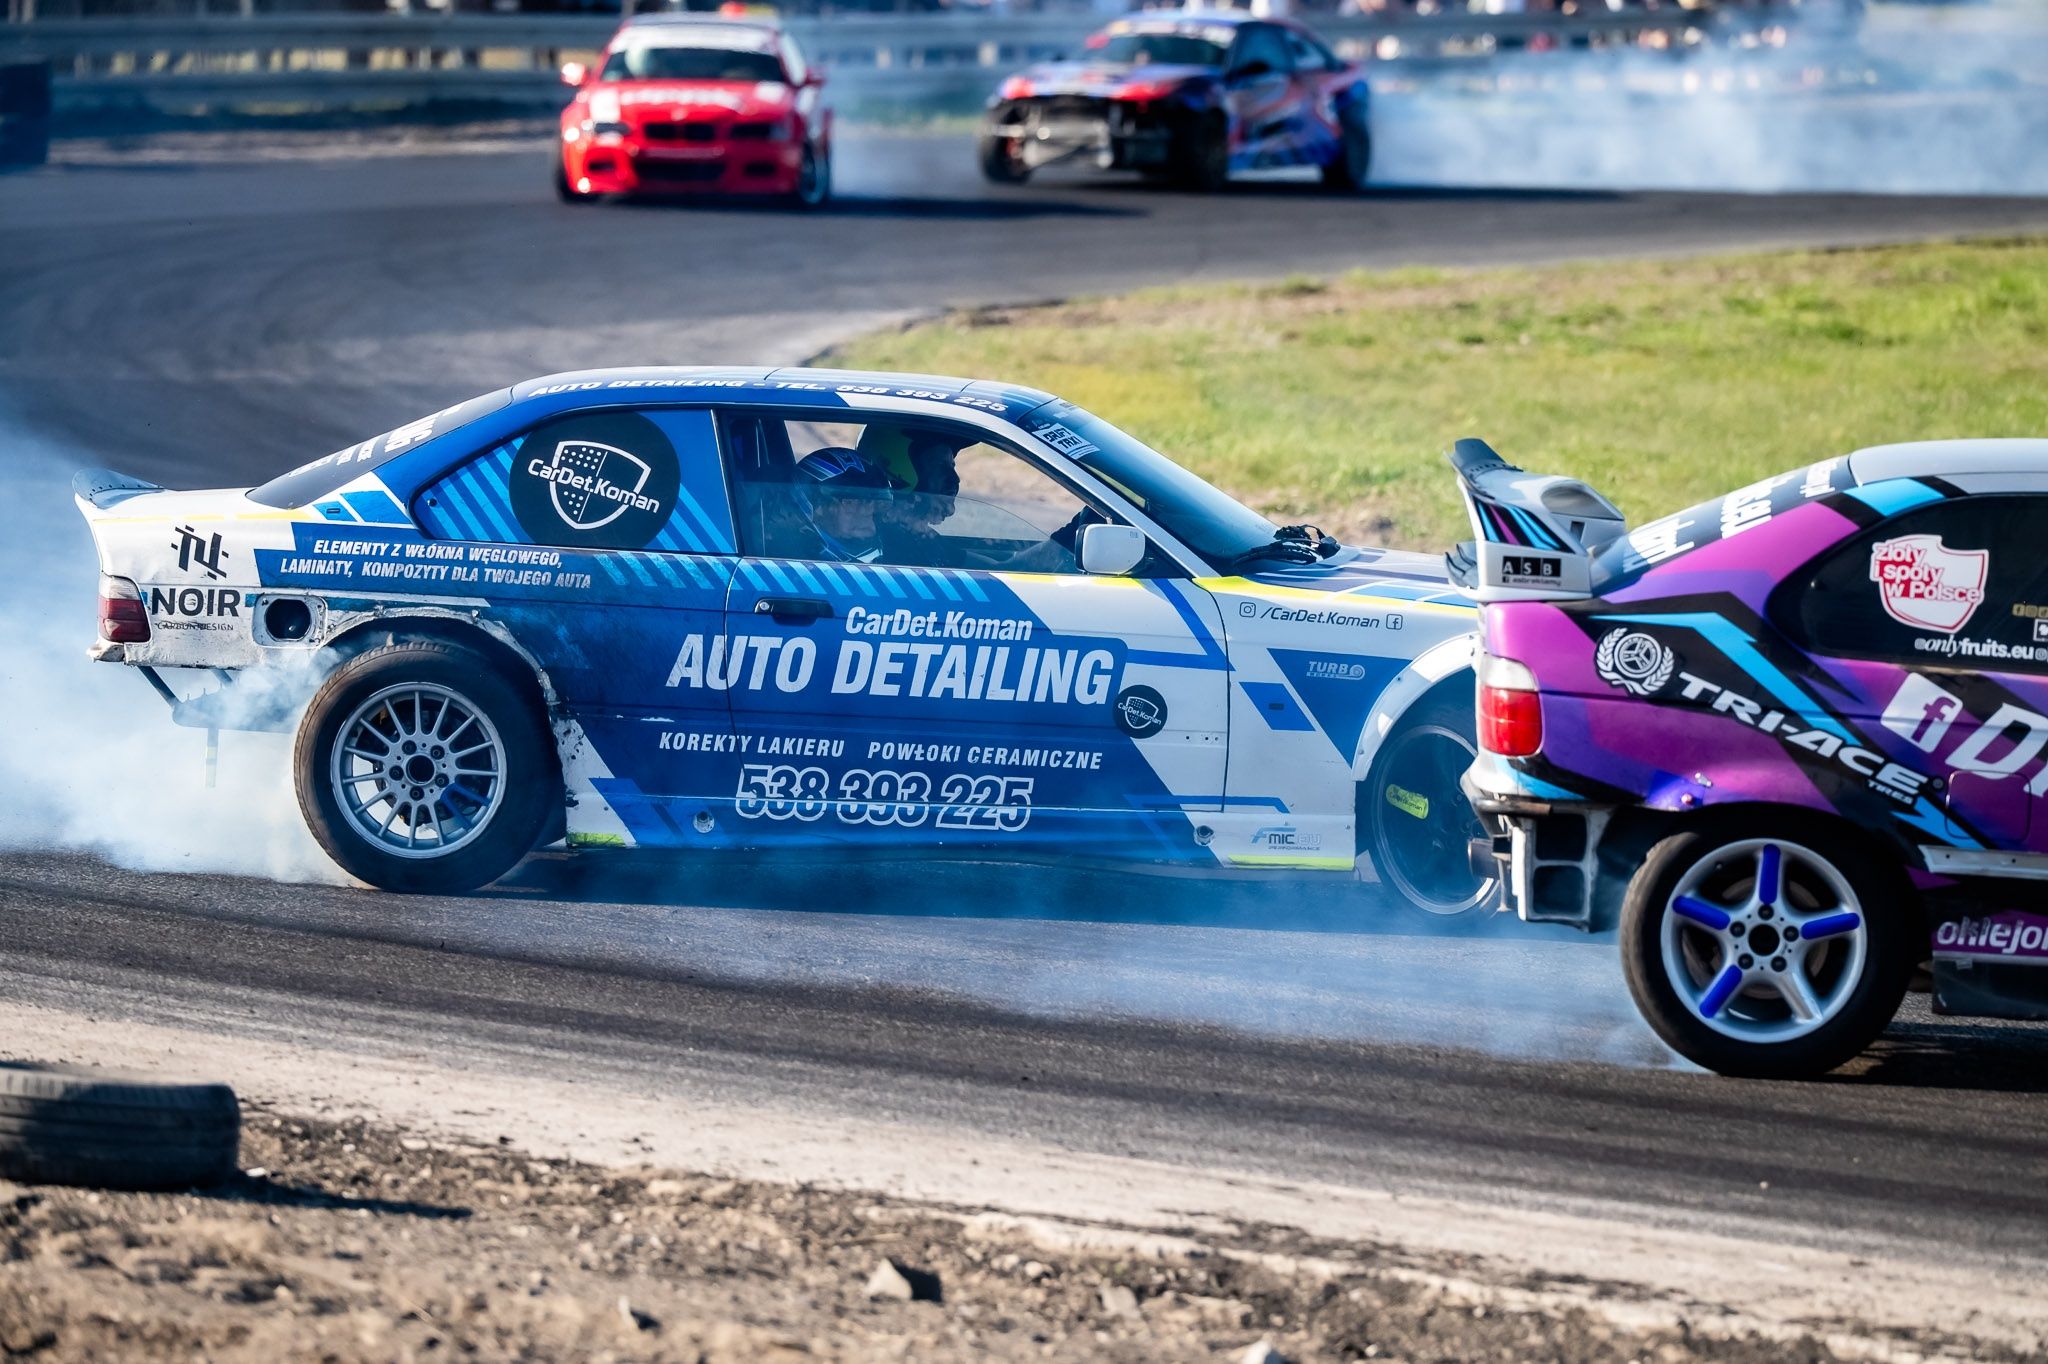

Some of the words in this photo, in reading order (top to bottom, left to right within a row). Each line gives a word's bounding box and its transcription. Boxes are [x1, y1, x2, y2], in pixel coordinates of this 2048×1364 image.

[527, 382, 602, 397] AUTO
[607, 380, 746, 388] DETAILING
[836, 385, 890, 394] 538
[896, 388, 951, 400] 393
[953, 397, 1009, 412] 225
[1043, 428, 1072, 443] DRIFT
[1057, 436, 1083, 449] TAXI
[528, 458, 660, 514] CarDet.Koman
[314, 540, 389, 557] ELEMENTY
[390, 544, 402, 557] Z
[405, 543, 464, 560] WŁÓKNA
[469, 547, 563, 569] WĘGLOWEGO,
[280, 558, 353, 577] LAMINATY,
[361, 561, 449, 580] KOMPOZYTY
[451, 566, 479, 581] DLA
[484, 568, 552, 586] TWOJEGO
[554, 573, 591, 588] AUTA
[151, 587, 240, 617] NOIR
[845, 606, 1033, 640] CarDet.Koman
[665, 633, 817, 693] AUTO
[831, 640, 1114, 704] DETAILING
[1118, 702, 1162, 724] CarDet.Koman
[1679, 671, 1928, 794] TRI-ACE
[659, 732, 753, 752] KOREKTY
[757, 736, 845, 758] LAKIERU
[867, 741, 962, 763] POWŁOKI
[967, 746, 1103, 770] CERAMICZNE
[735, 764, 830, 822] 538
[836, 769, 932, 827] 393
[936, 774, 1034, 832] 225
[1868, 780, 1914, 805] TIRES
